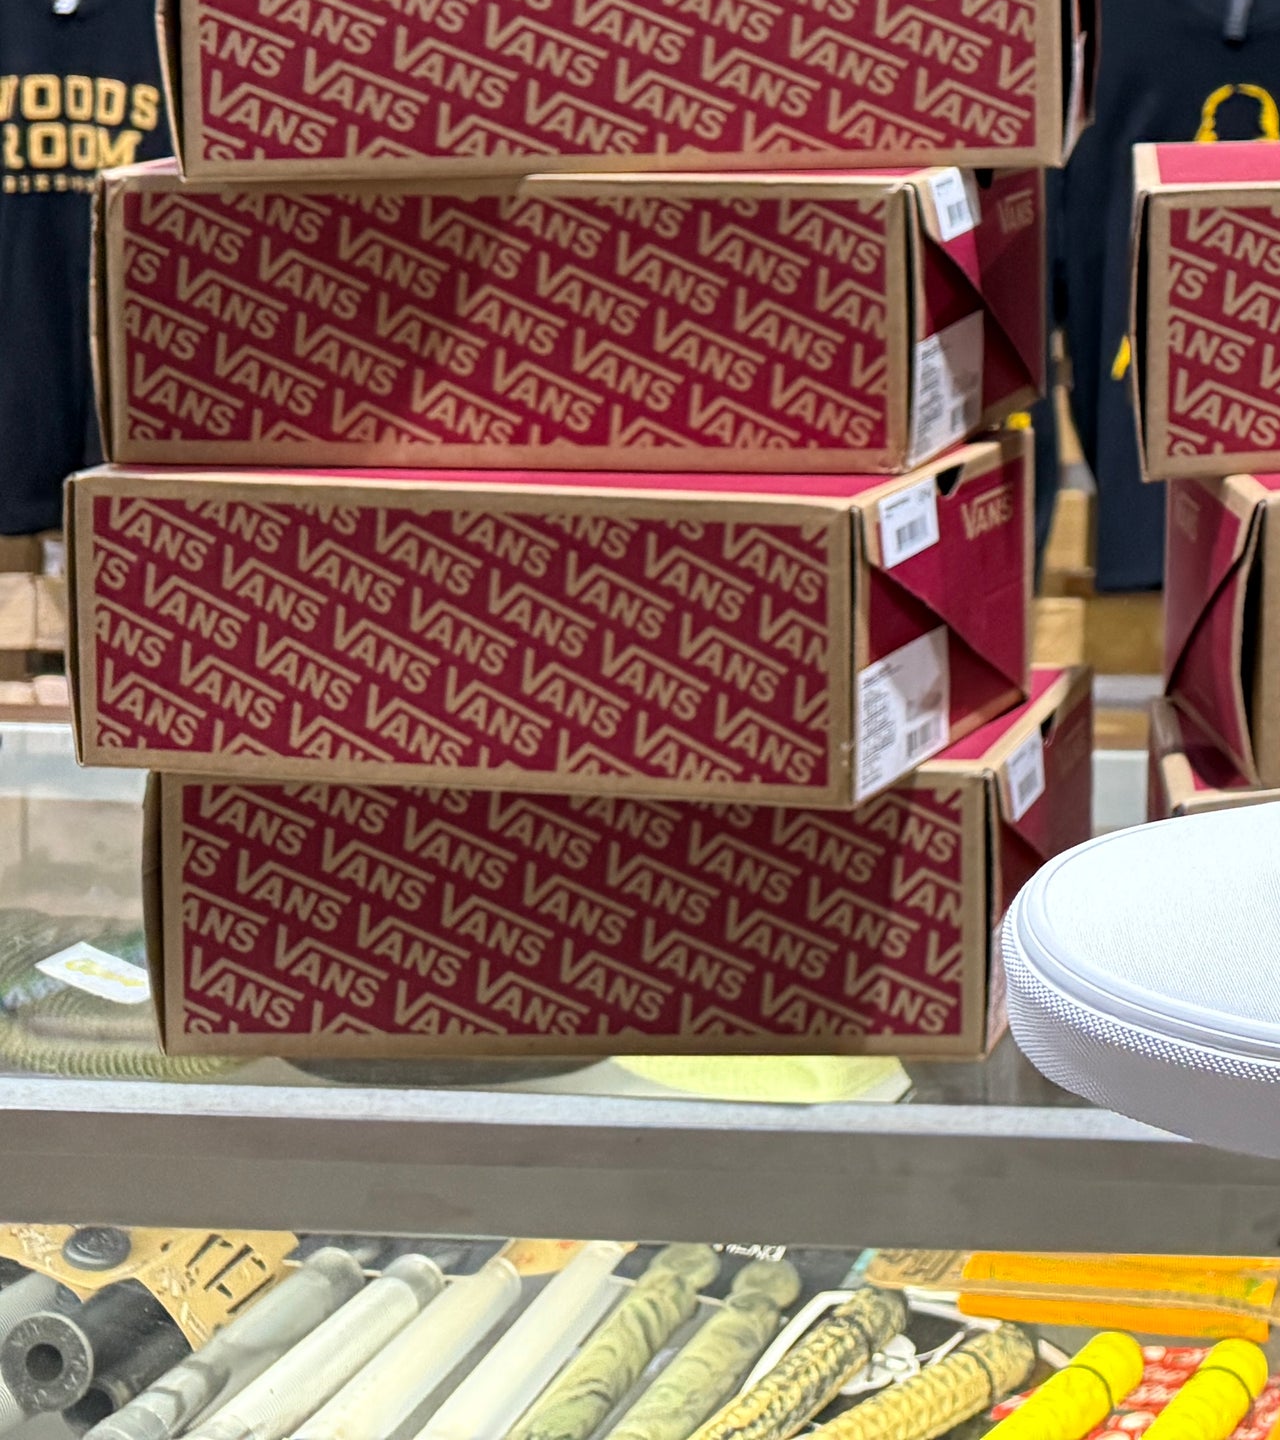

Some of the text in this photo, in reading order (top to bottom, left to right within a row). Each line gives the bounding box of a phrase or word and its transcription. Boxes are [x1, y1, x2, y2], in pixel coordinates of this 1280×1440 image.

[210, 70, 336, 154] VANS
[303, 48, 428, 130] VANS
[395, 26, 518, 108] VANS
[527, 80, 648, 154] VANS
[486, 4, 608, 86] VANS
[616, 58, 735, 139] VANS
[704, 36, 821, 116] VANS
[790, 14, 906, 95] VANS
[914, 67, 1028, 146] VANS
[222, 193, 332, 243] ANS
[340, 216, 450, 299] VANS
[457, 272, 567, 355] VANS
[574, 328, 684, 410] VANS
[618, 231, 728, 314] VANS
[735, 287, 844, 370] VANS
[698, 211, 808, 294] VANS
[779, 200, 887, 274] VANS
[141, 192, 251, 263] VANS
[259, 236, 369, 319] VANS
[376, 292, 486, 375] VANS
[494, 348, 603, 431] VANS
[178, 256, 288, 340] VANS
[296, 312, 406, 395] VANS
[413, 368, 523, 444] VANS
[214, 332, 325, 416] VANS
[420, 196, 530, 278] VANS
[538, 252, 647, 334] VANS
[654, 308, 764, 390] VANS
[771, 363, 880, 446] VANS
[134, 353, 244, 436] VANS
[645, 532, 752, 621] VANS
[724, 523, 830, 603] VANS
[960, 485, 1013, 540] VANS
[111, 495, 215, 570] VANS
[222, 544, 326, 632] VANS
[333, 605, 438, 693] VANS
[445, 666, 551, 755] VANS
[145, 562, 250, 649] VANS
[256, 623, 361, 711] VANS
[368, 684, 473, 765] VANS
[188, 498, 292, 552] ANS
[299, 526, 404, 614] VANS
[411, 587, 516, 675] VANS
[523, 648, 629, 737] VANS
[376, 508, 482, 596] VANS
[488, 569, 595, 657] VANS
[601, 630, 708, 719] VANS
[714, 692, 822, 782] VANS
[567, 551, 673, 639] VANS
[680, 612, 787, 702] VANS
[102, 658, 206, 746] VANS
[179, 641, 284, 728] VANS
[201, 784, 314, 855] VANS
[322, 828, 435, 910] VANS
[442, 883, 554, 966] VANS
[561, 938, 673, 1020] VANS
[285, 785, 398, 834] ANS
[405, 807, 518, 890] VANS
[525, 862, 637, 944] VANS
[644, 917, 755, 1000] VANS
[690, 821, 801, 903] VANS
[808, 876, 919, 958] VANS
[772, 805, 883, 883] VANS
[238, 848, 351, 931] VANS
[358, 904, 471, 986] VANS
[478, 959, 590, 1034] VANS
[274, 924, 388, 1007] VANS
[488, 789, 601, 869] VANS
[608, 842, 719, 924] VANS
[726, 897, 837, 978] VANS
[844, 952, 955, 1033] VANS
[190, 946, 304, 1028] VANS
